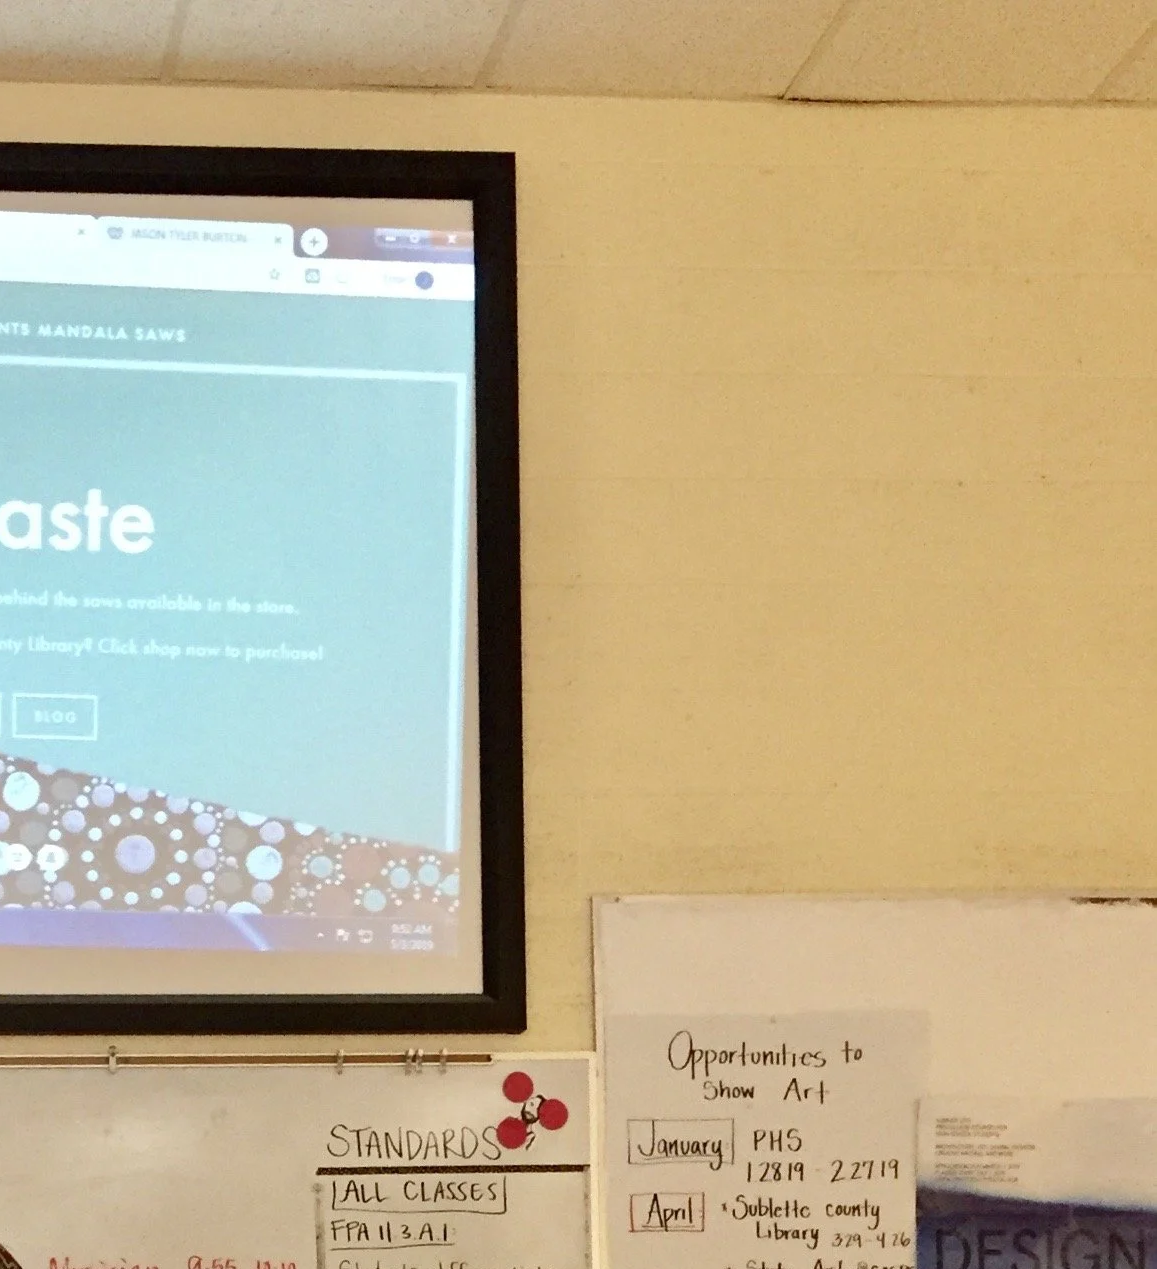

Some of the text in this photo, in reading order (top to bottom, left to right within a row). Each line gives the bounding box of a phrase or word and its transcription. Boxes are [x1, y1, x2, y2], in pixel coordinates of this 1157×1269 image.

[130, 228, 249, 245] JASON TYLER BURTON
[37, 324, 128, 341] MANDALA
[134, 326, 186, 343] SAWS
[53, 591, 78, 608] the
[83, 595, 123, 609] saws
[127, 594, 202, 612] available
[207, 597, 222, 612] in
[227, 597, 253, 614] the
[256, 601, 301, 616] store.
[28, 636, 92, 657] Library?
[97, 637, 138, 656] Click
[143, 640, 180, 660] shop
[186, 644, 221, 658] now
[225, 644, 240, 659] to
[245, 643, 324, 663] purchase!
[34, 709, 77, 724] BLOG
[668, 1030, 863, 1080] Opportunities to
[703, 1078, 830, 1105] Show Art
[327, 1124, 502, 1161] STANDARDS
[638, 1120, 723, 1171] January
[753, 1128, 802, 1152] PHS
[340, 1180, 498, 1203] ALL CLASSES
[647, 1192, 694, 1233] April
[732, 1194, 811, 1220] Sublette
[330, 1219, 370, 1243] FPA
[756, 1221, 819, 1250] Library
